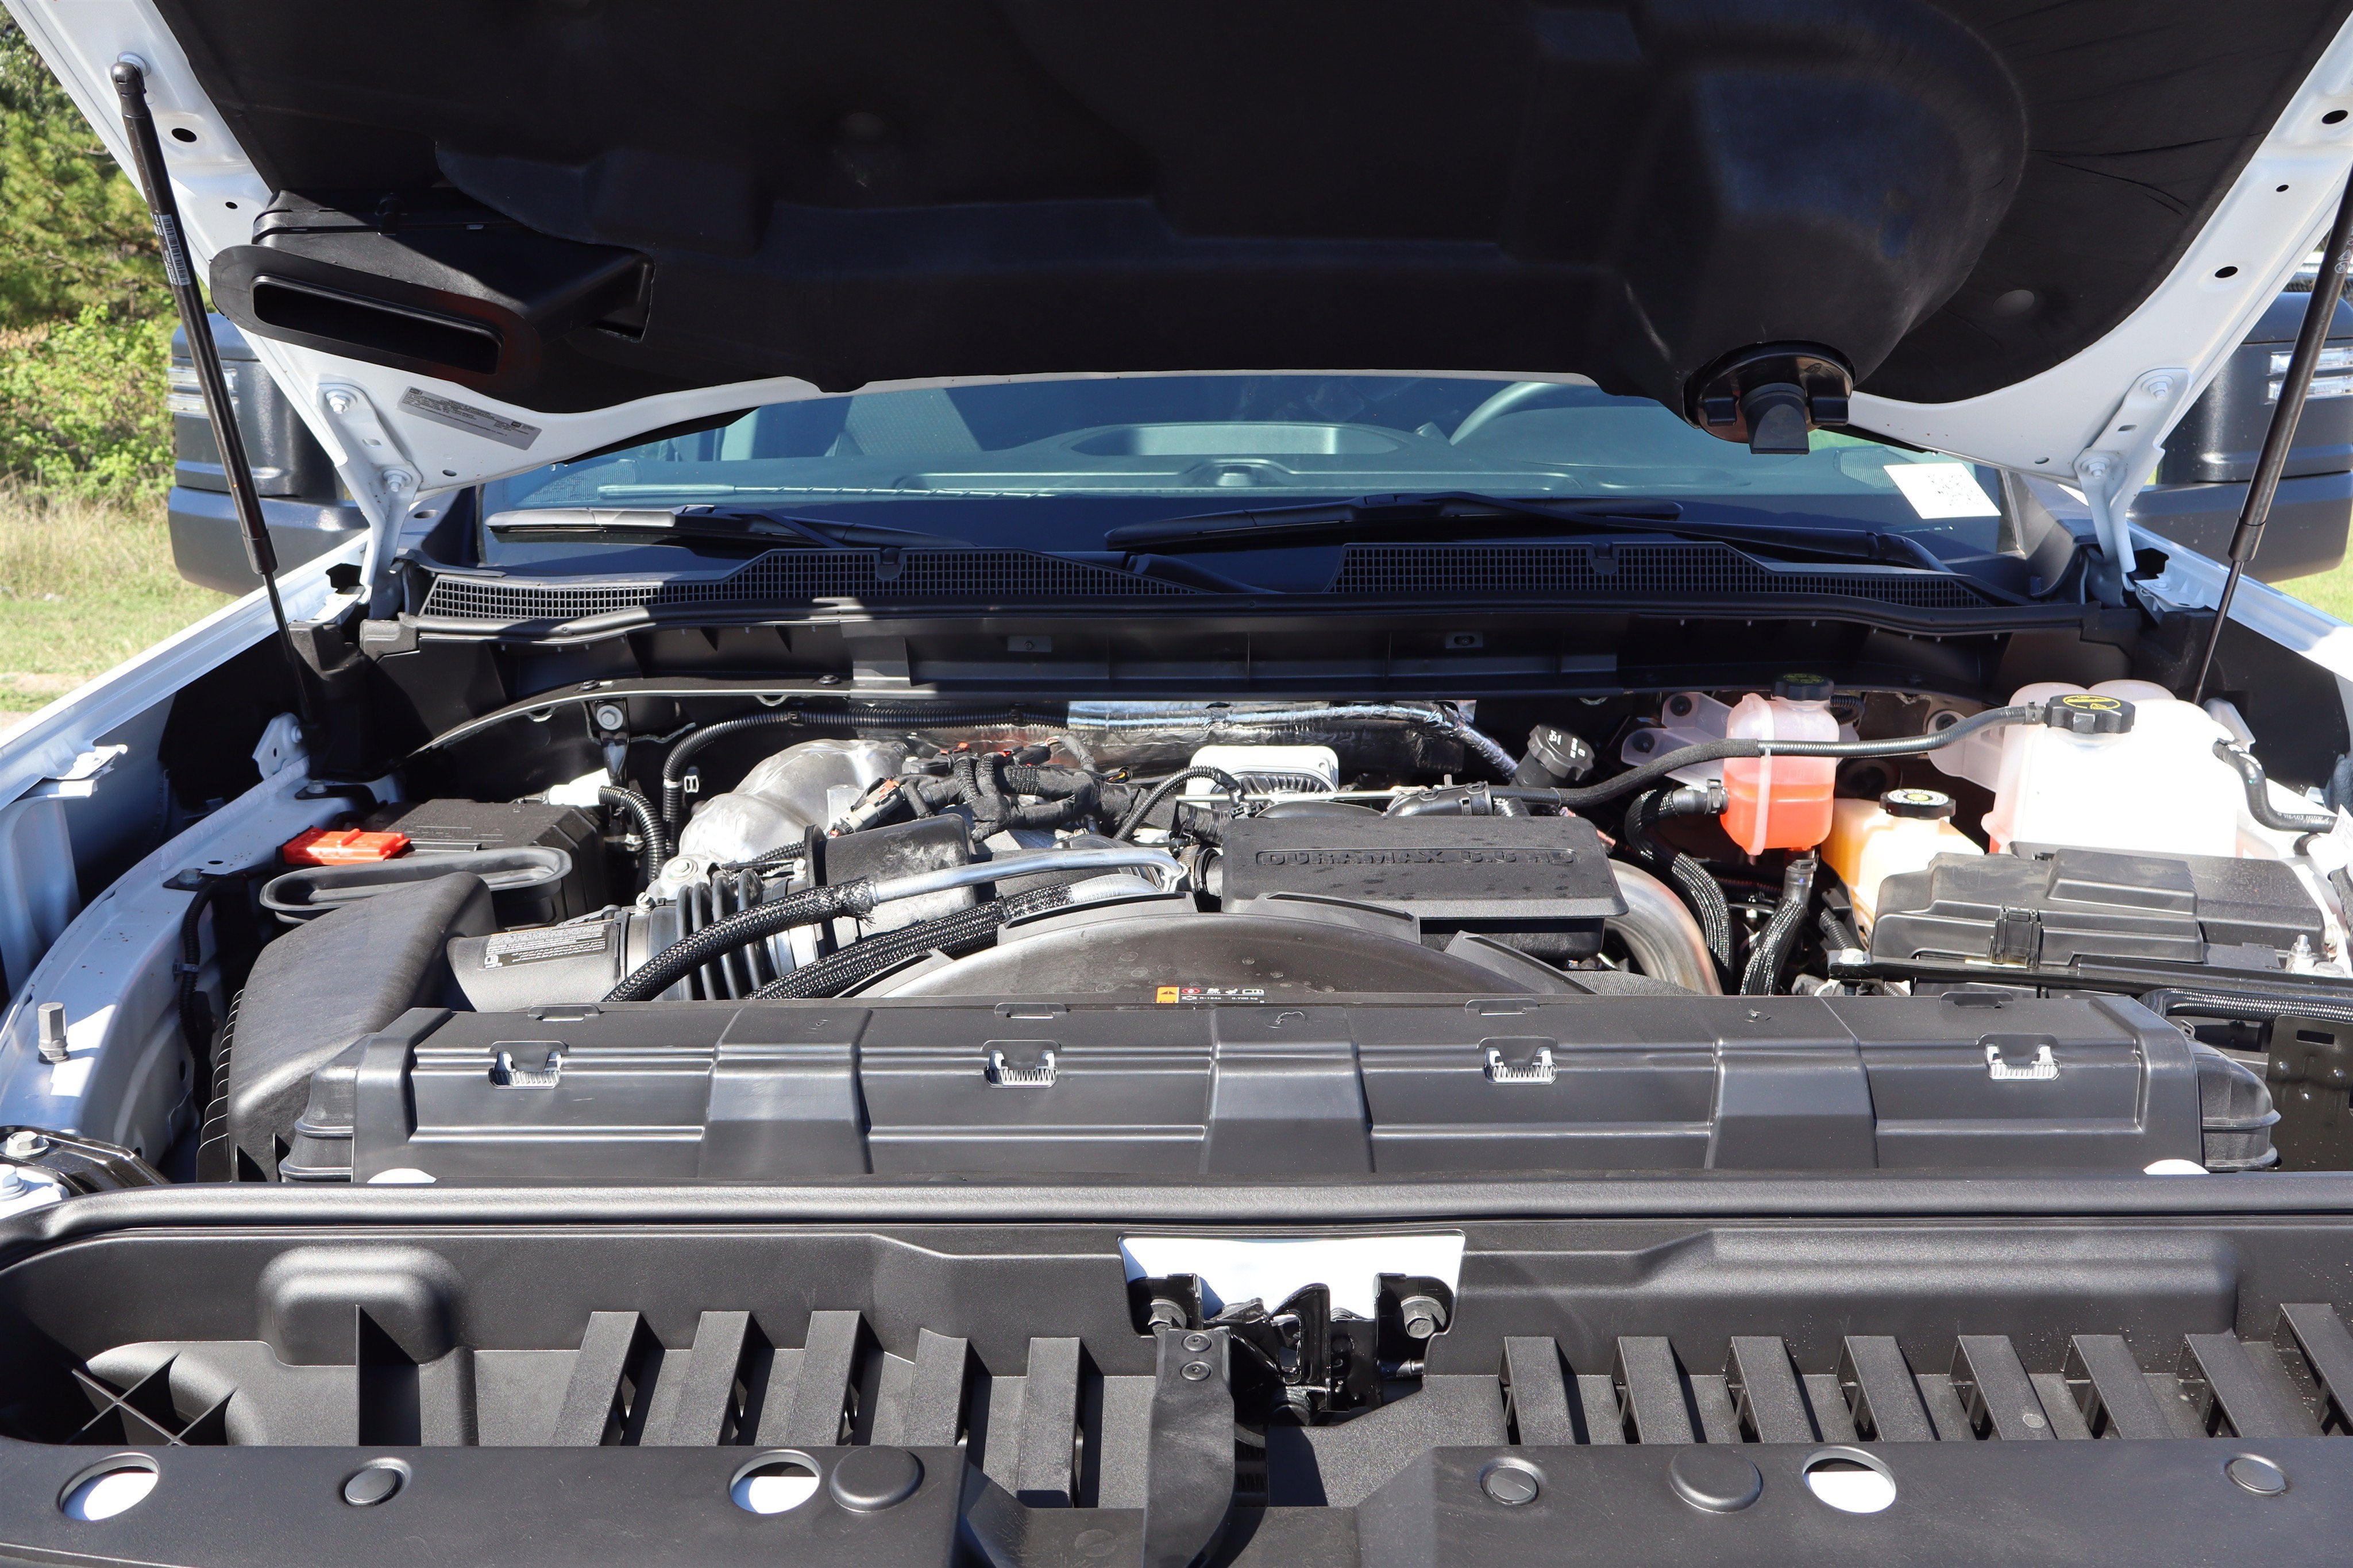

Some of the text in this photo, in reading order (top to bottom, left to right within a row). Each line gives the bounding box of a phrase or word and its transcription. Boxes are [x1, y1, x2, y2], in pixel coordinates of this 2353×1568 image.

[1265, 850, 1574, 864] DURAMAX 6.6 HD
